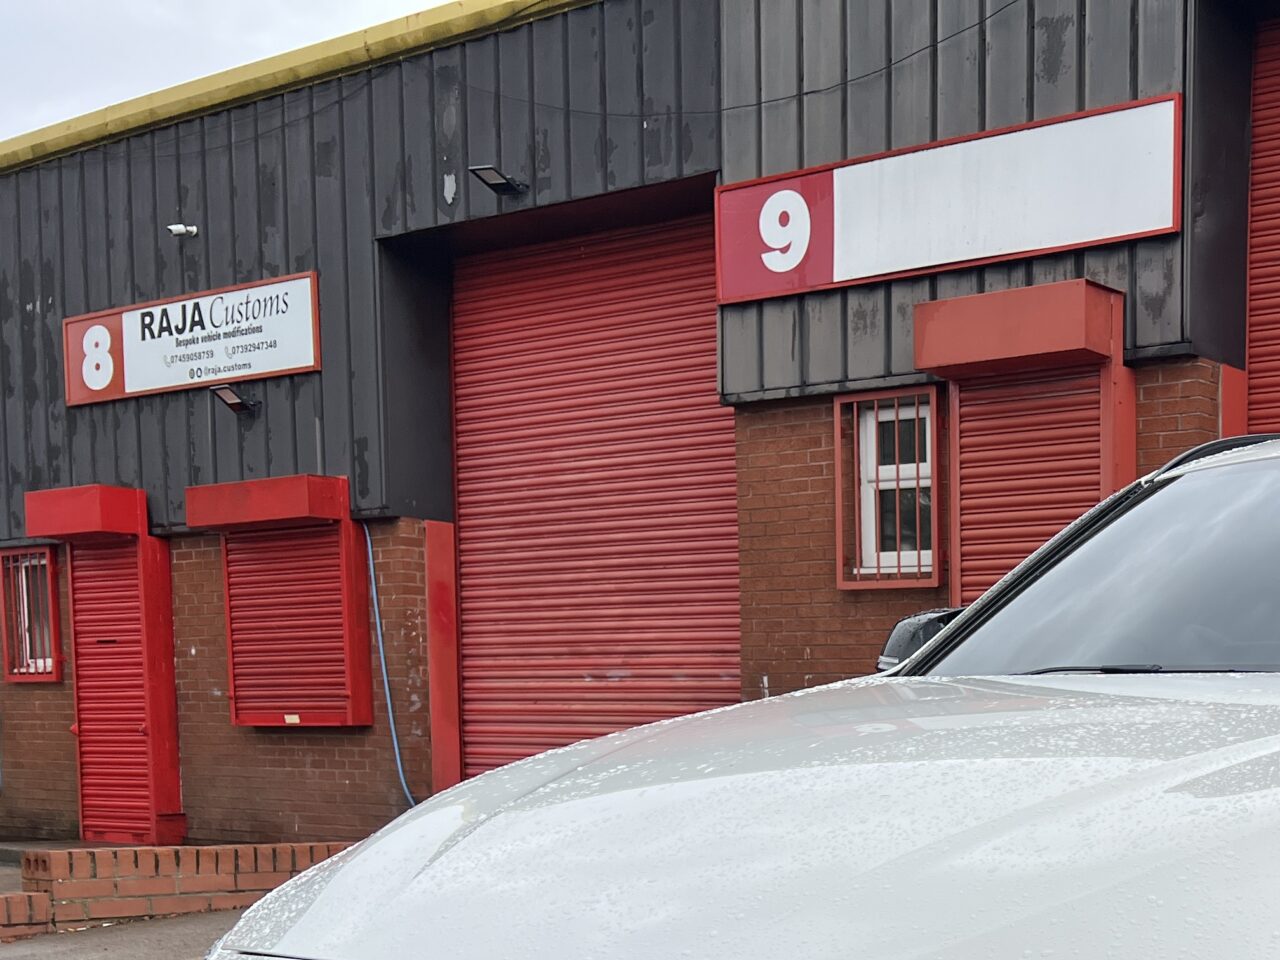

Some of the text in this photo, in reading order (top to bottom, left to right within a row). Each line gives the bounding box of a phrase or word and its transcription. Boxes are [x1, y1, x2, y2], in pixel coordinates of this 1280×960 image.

[759, 189, 811, 273] 9
[140, 291, 289, 341] RAJA Customs
[201, 331, 221, 345] vehicle
[223, 324, 263, 340] modifications
[82, 325, 114, 391] 8
